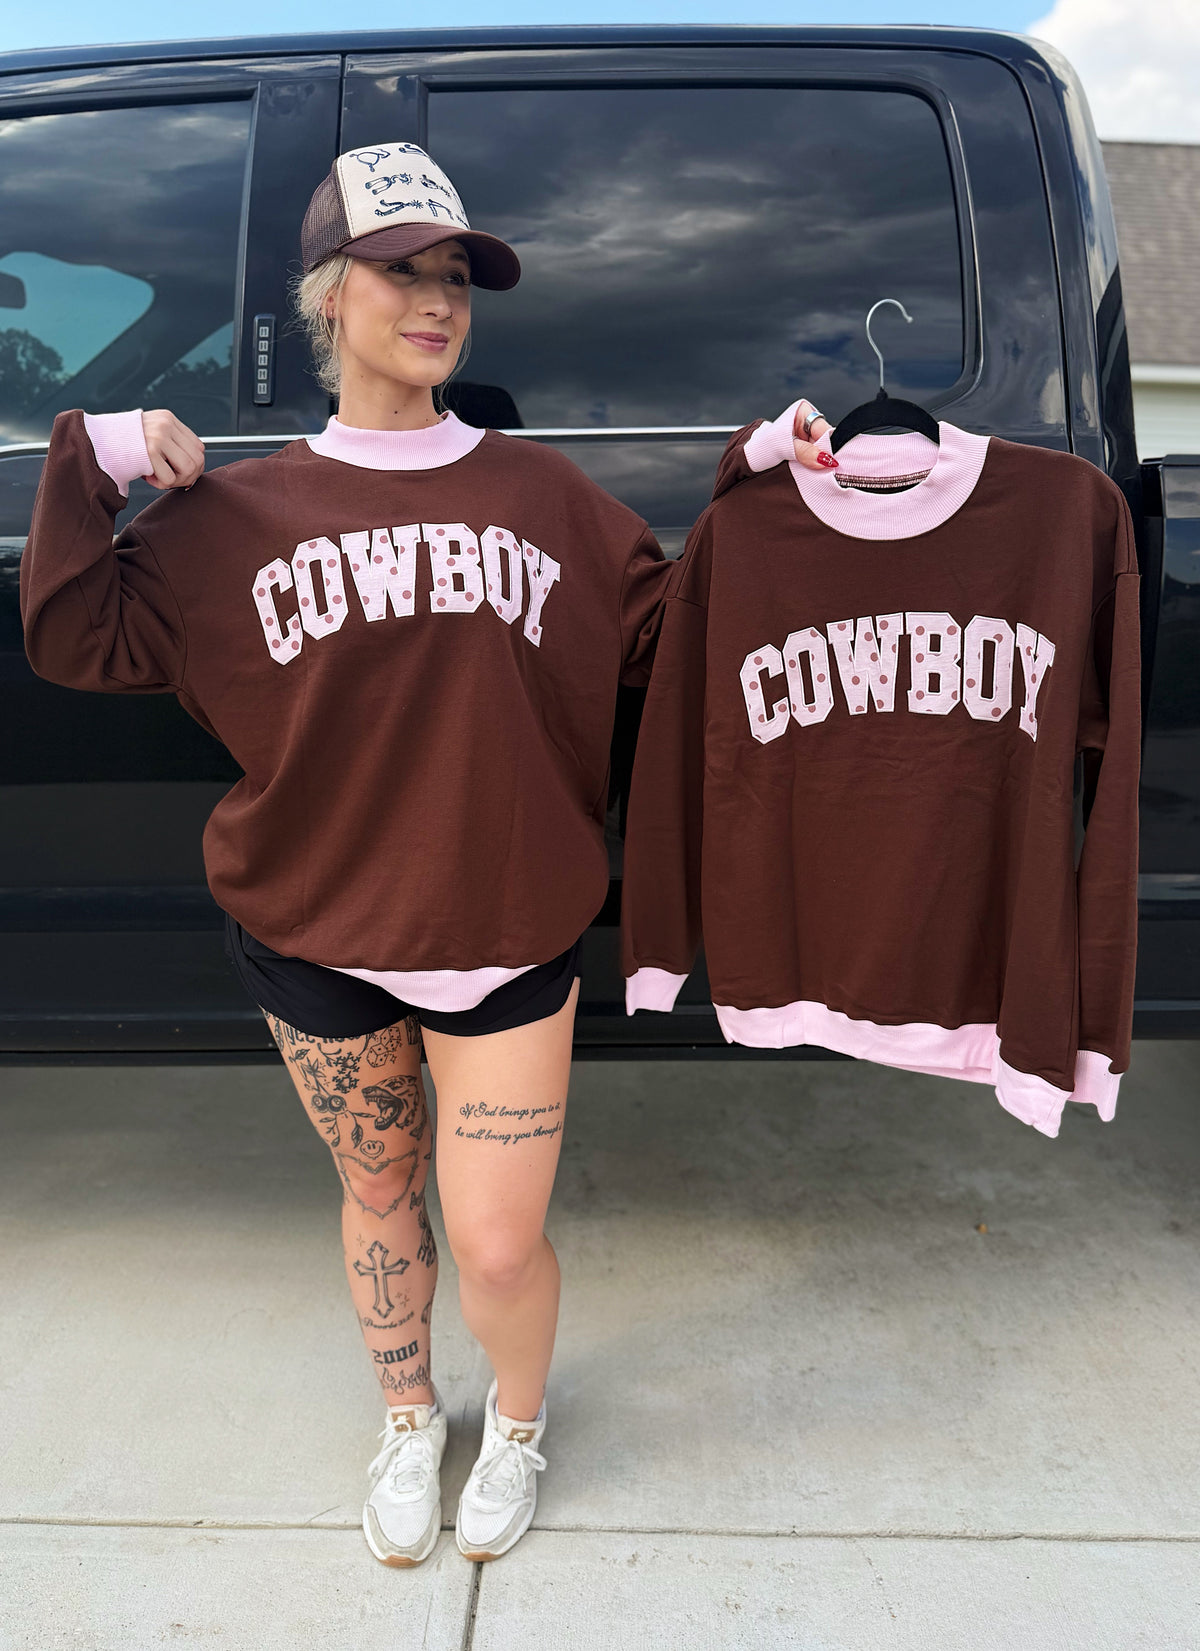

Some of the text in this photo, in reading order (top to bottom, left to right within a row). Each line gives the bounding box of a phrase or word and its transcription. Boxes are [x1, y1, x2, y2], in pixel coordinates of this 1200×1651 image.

[252, 523, 560, 665] COWBOY
[740, 612, 1055, 744] COWBOY
[474, 1102, 498, 1117] God
[499, 1106, 529, 1120] brings
[530, 1107, 546, 1119] you
[455, 1127, 464, 1137] he
[466, 1129, 485, 1140] will
[485, 1129, 511, 1145] bring
[513, 1133, 531, 1144] you
[372, 1339, 418, 1364] 2000
